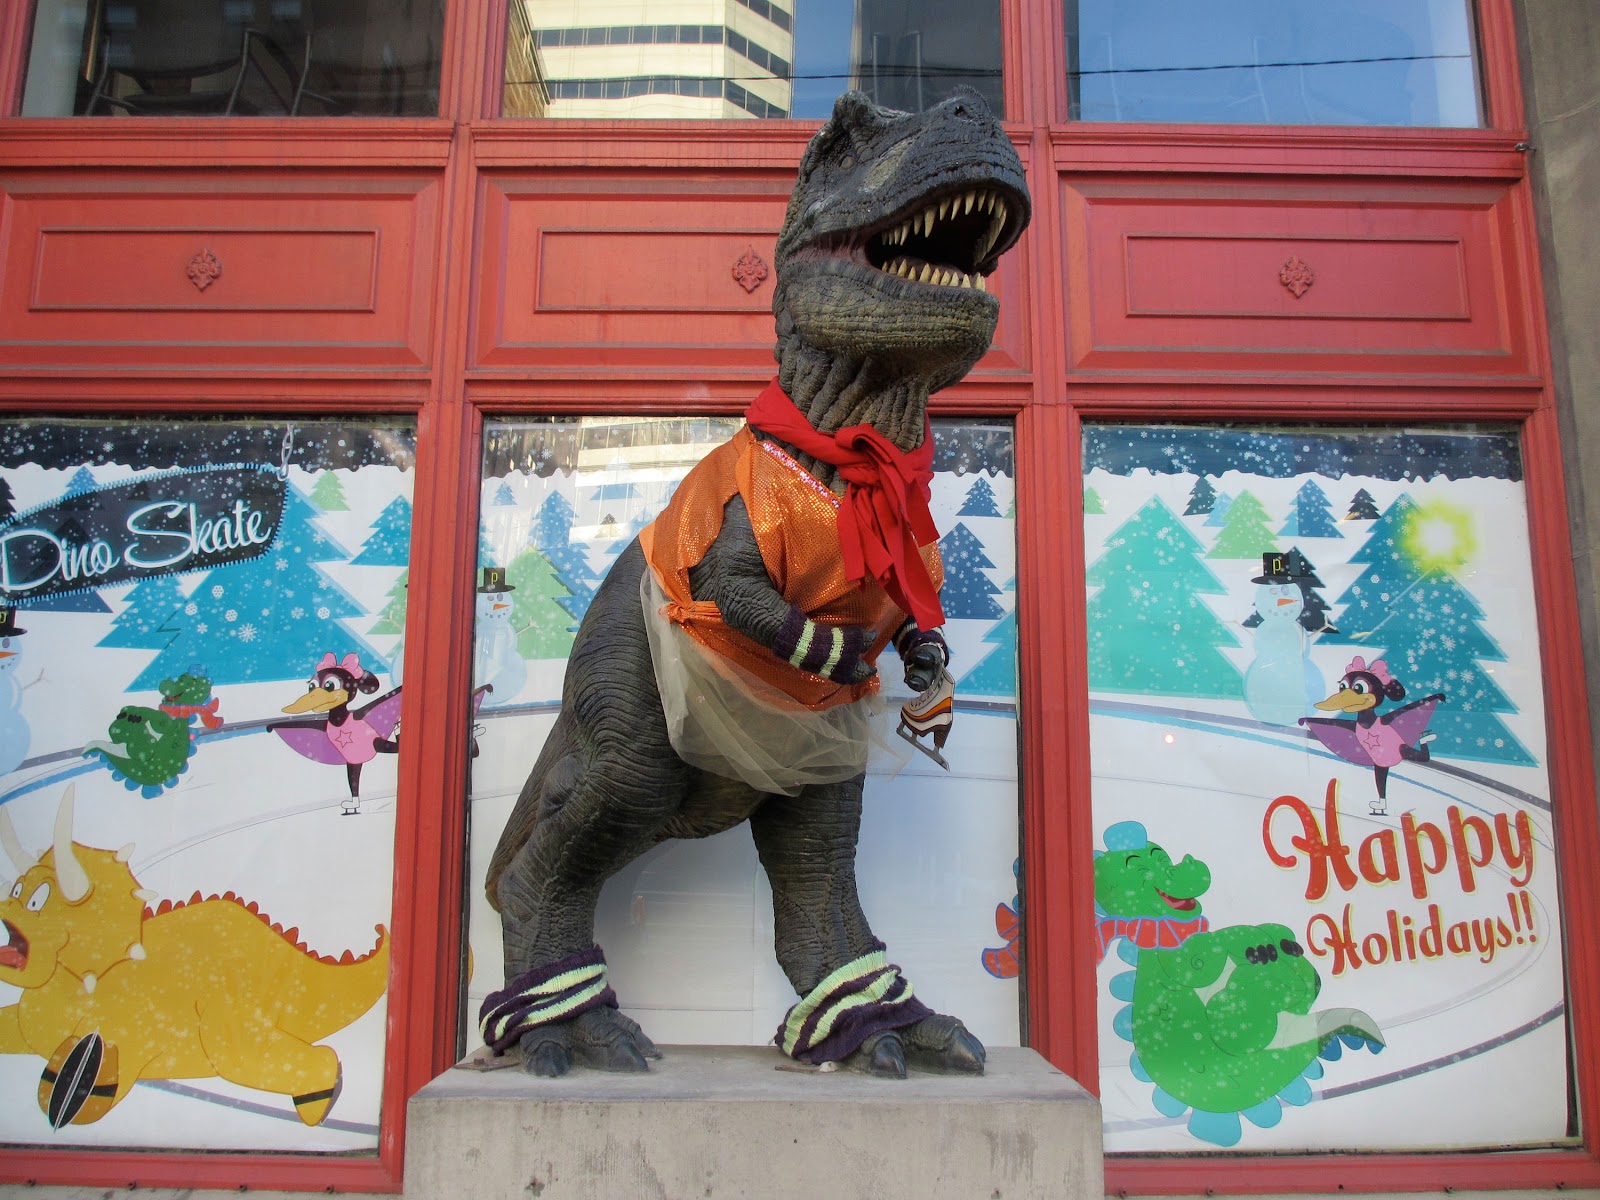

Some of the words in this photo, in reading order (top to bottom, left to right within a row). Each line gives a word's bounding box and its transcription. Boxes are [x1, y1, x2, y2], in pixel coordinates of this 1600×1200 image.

[0, 529, 121, 592] Dino
[124, 500, 272, 568] Skate
[1262, 778, 1535, 900] Happy
[1306, 890, 1537, 976] Holidays!!
